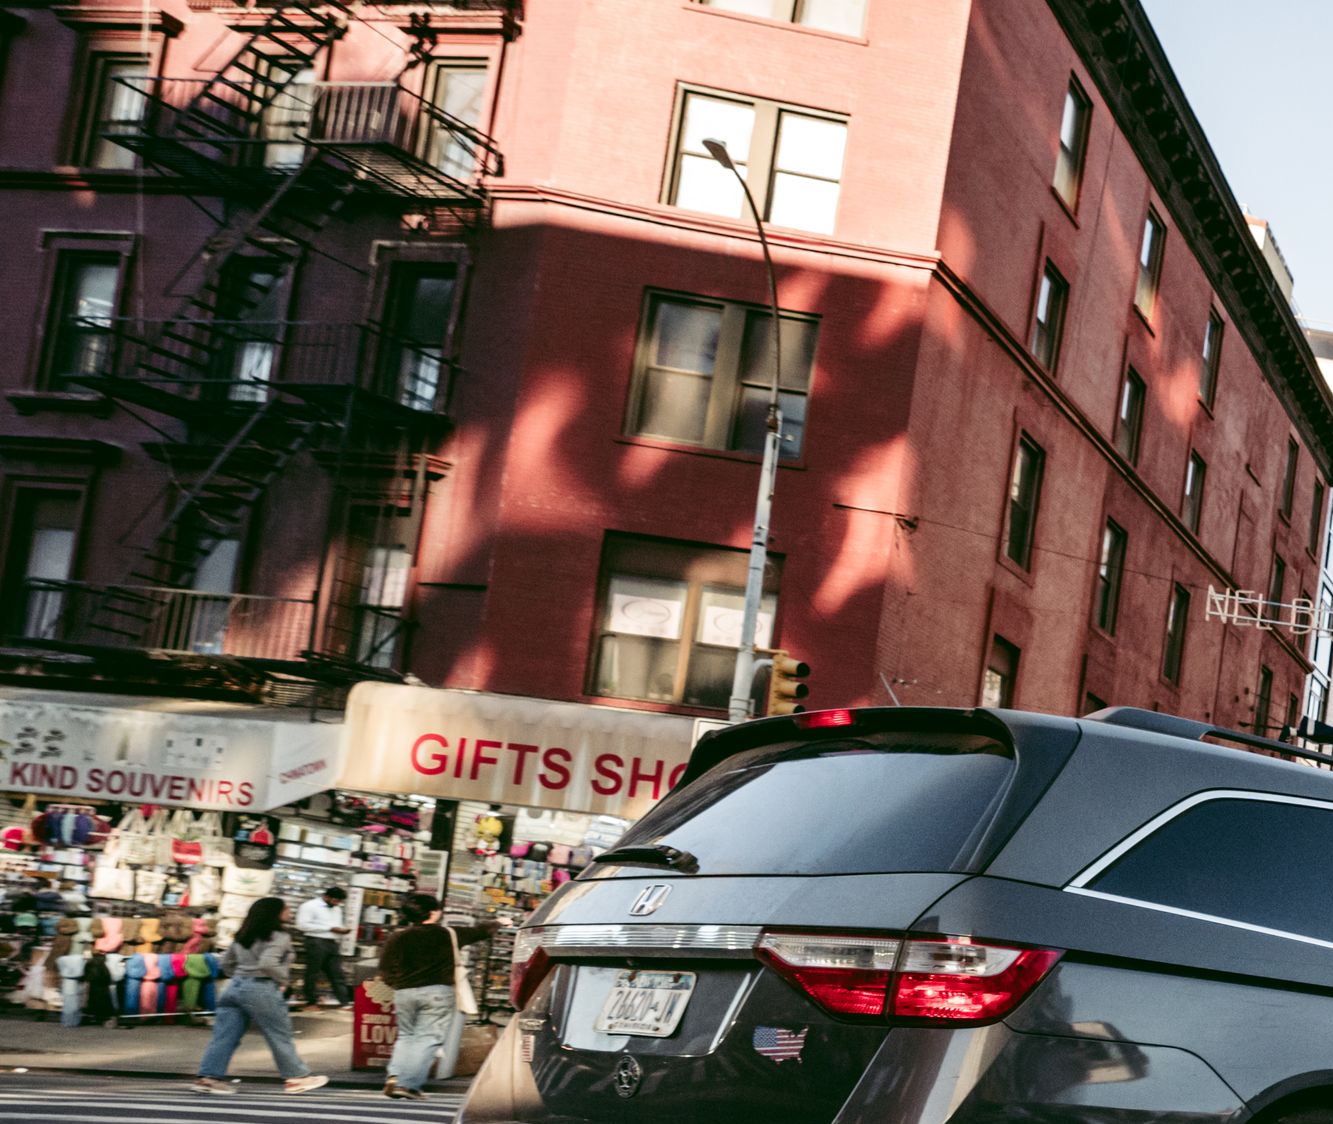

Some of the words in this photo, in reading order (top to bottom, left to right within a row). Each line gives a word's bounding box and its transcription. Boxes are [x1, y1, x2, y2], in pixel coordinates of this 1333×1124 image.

[1205, 584, 1273, 630] NEL
[9, 762, 79, 790] KIND
[87, 768, 255, 807] SOUVENIRS
[410, 733, 573, 791] GIFTS
